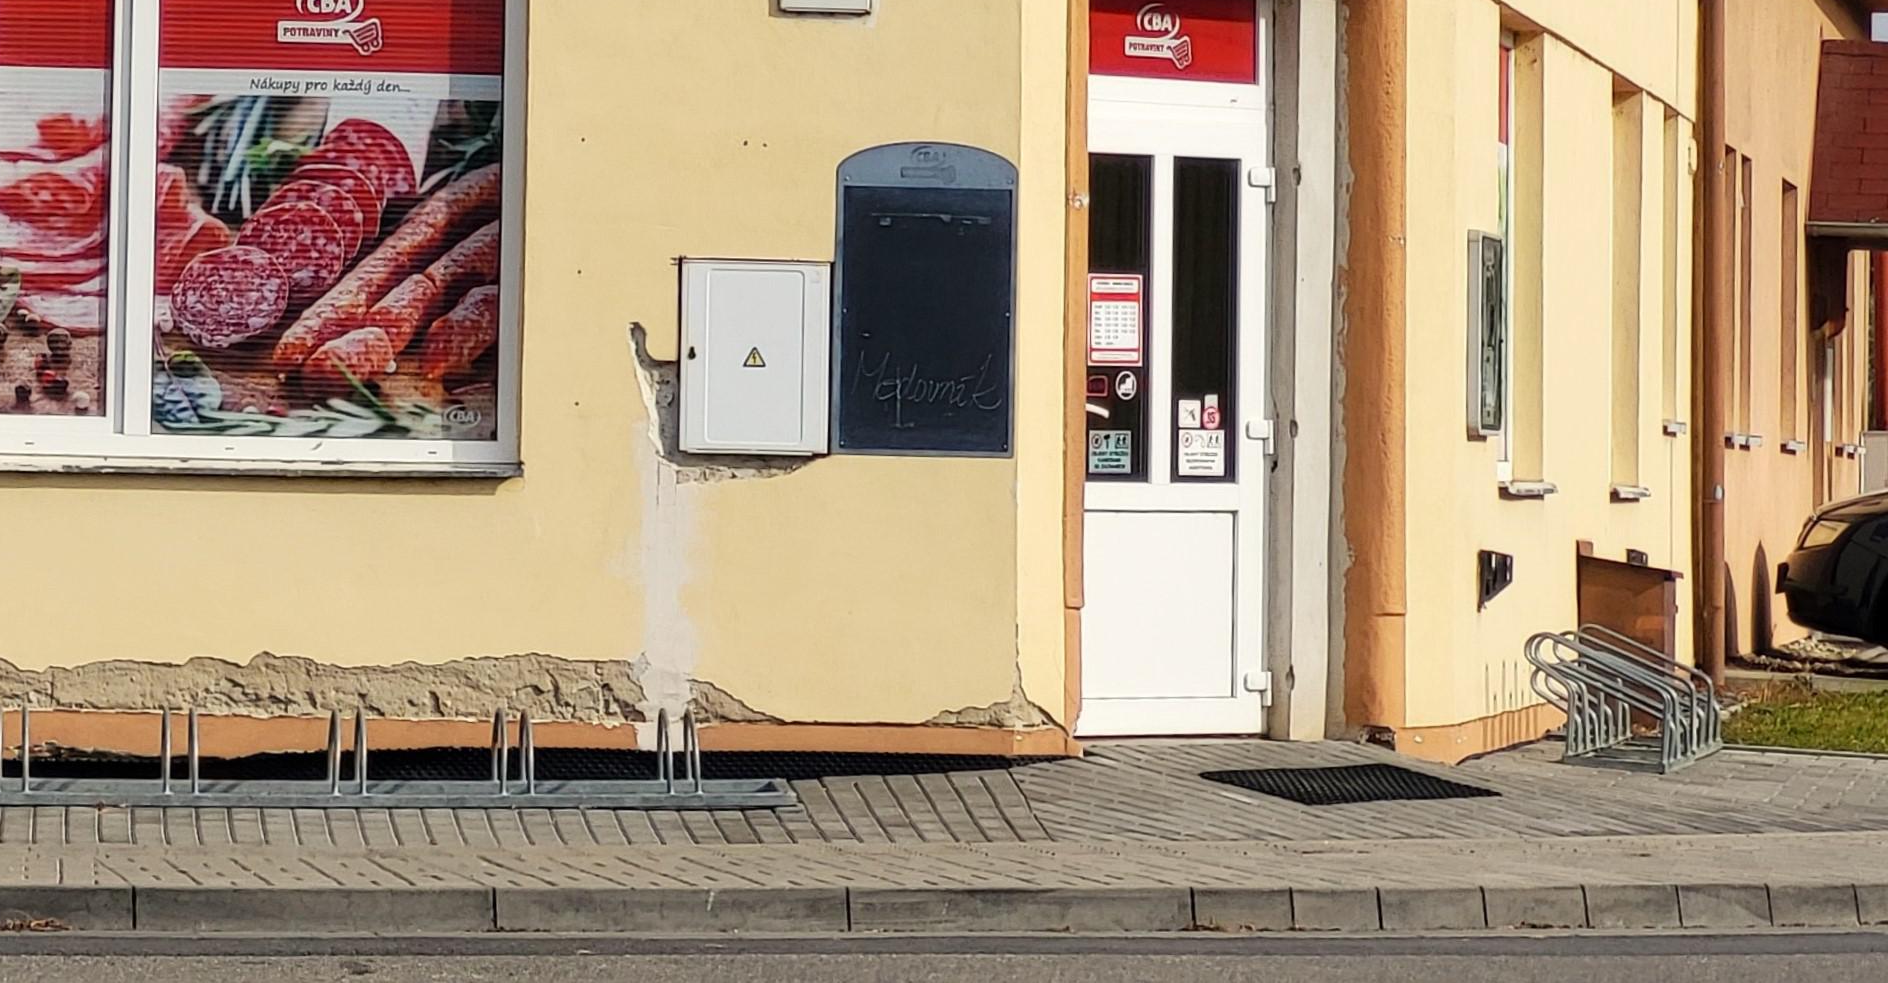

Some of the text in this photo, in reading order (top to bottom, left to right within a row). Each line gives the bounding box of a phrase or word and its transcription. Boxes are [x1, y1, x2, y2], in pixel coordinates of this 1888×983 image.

[1143, 13, 1173, 32] CBA
[283, 27, 340, 37] POTRAVINY
[249, 77, 300, 93] Nákupy
[304, 80, 328, 94] pro
[333, 79, 372, 95] každý
[449, 409, 476, 423] CBA
